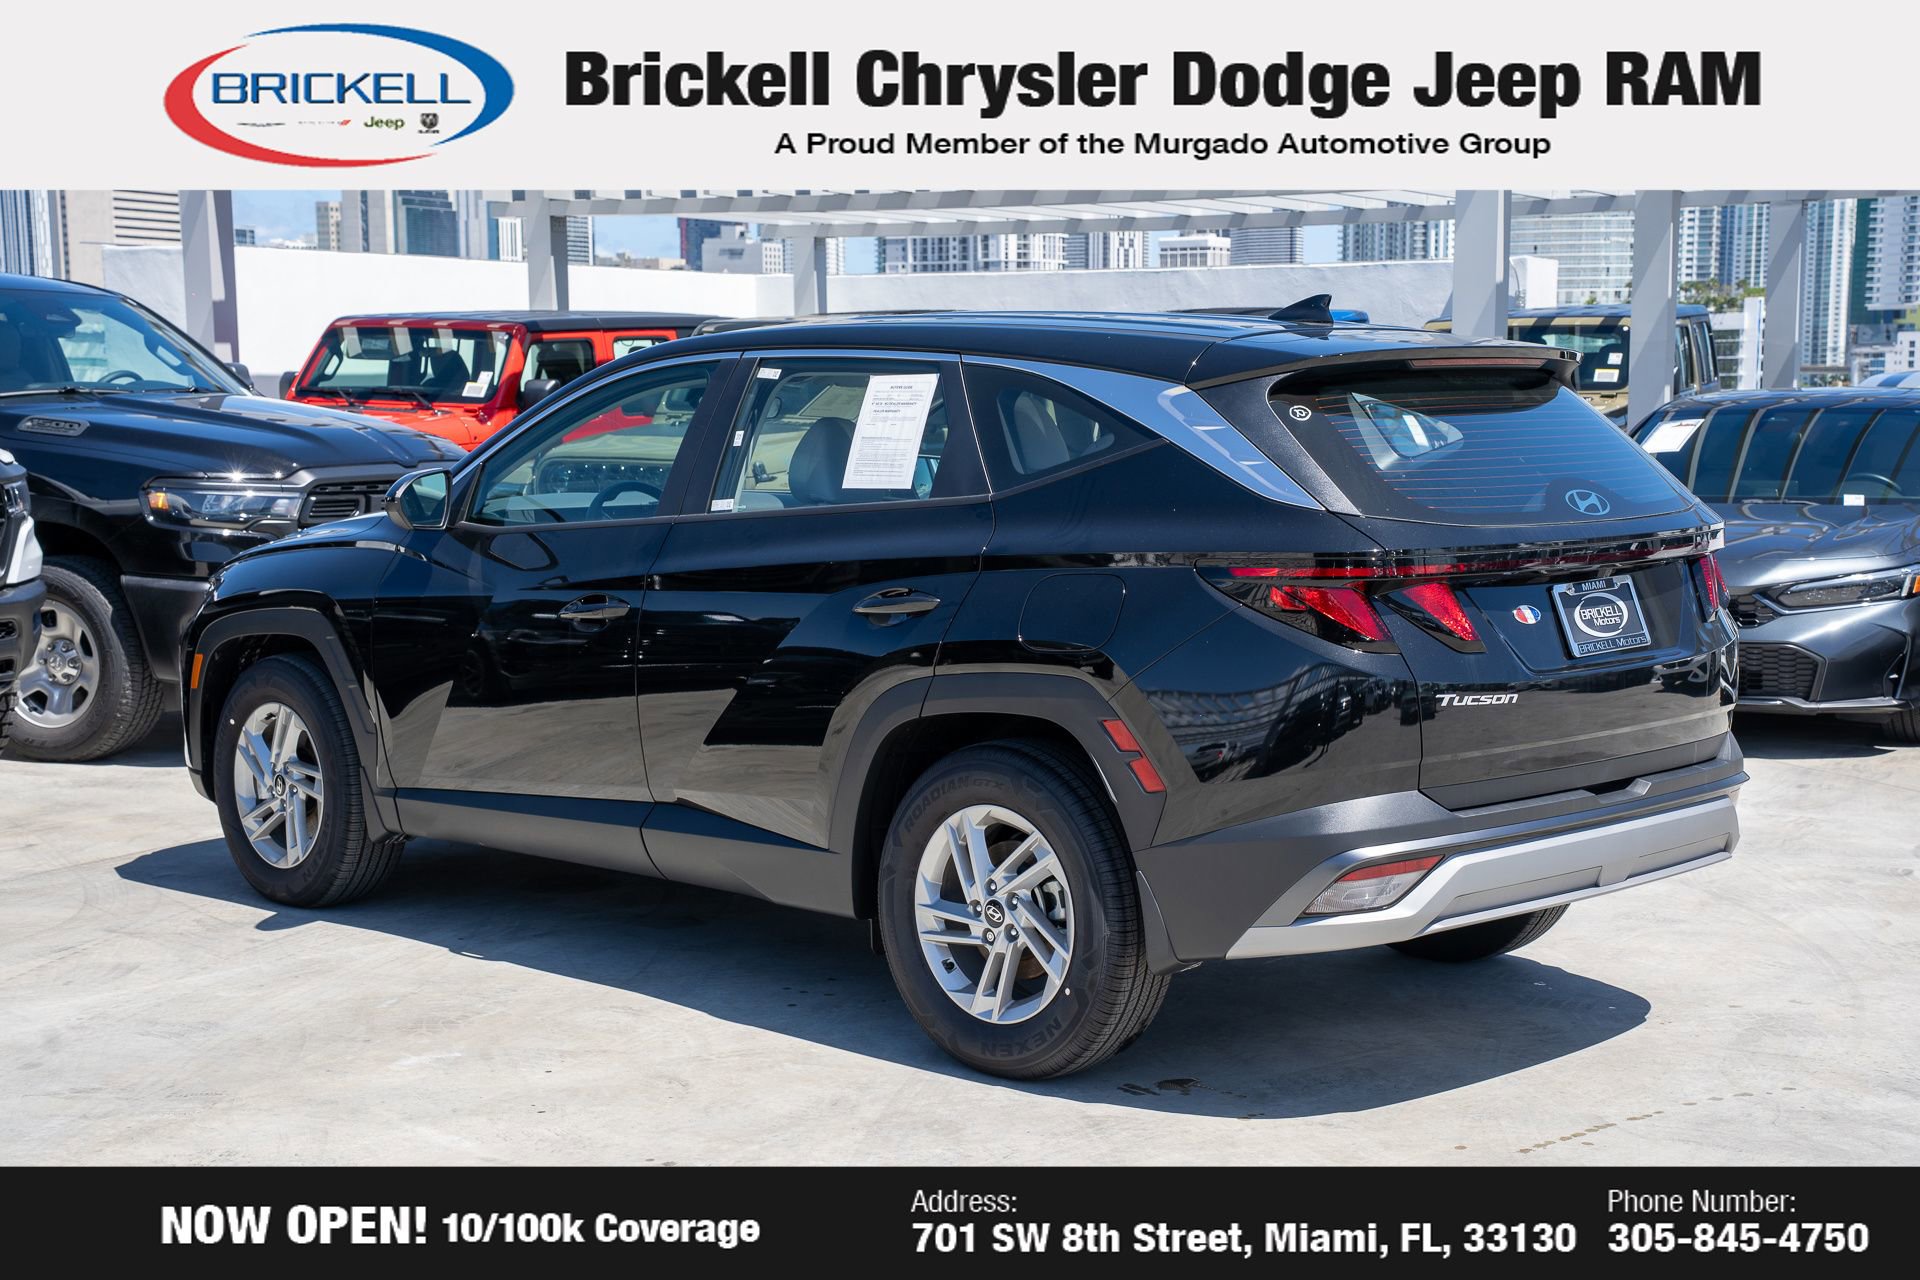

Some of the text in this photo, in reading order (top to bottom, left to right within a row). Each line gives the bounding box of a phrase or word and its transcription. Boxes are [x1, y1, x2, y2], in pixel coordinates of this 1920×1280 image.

[1581, 580, 1606, 591] MIAMI
[1580, 605, 1622, 620] BRICKELL
[1594, 617, 1620, 626] Motors
[1579, 636, 1646, 653] BRICKELL Motors
[904, 776, 970, 832] ROADIAN
[981, 1016, 1062, 1057] NEXEN
